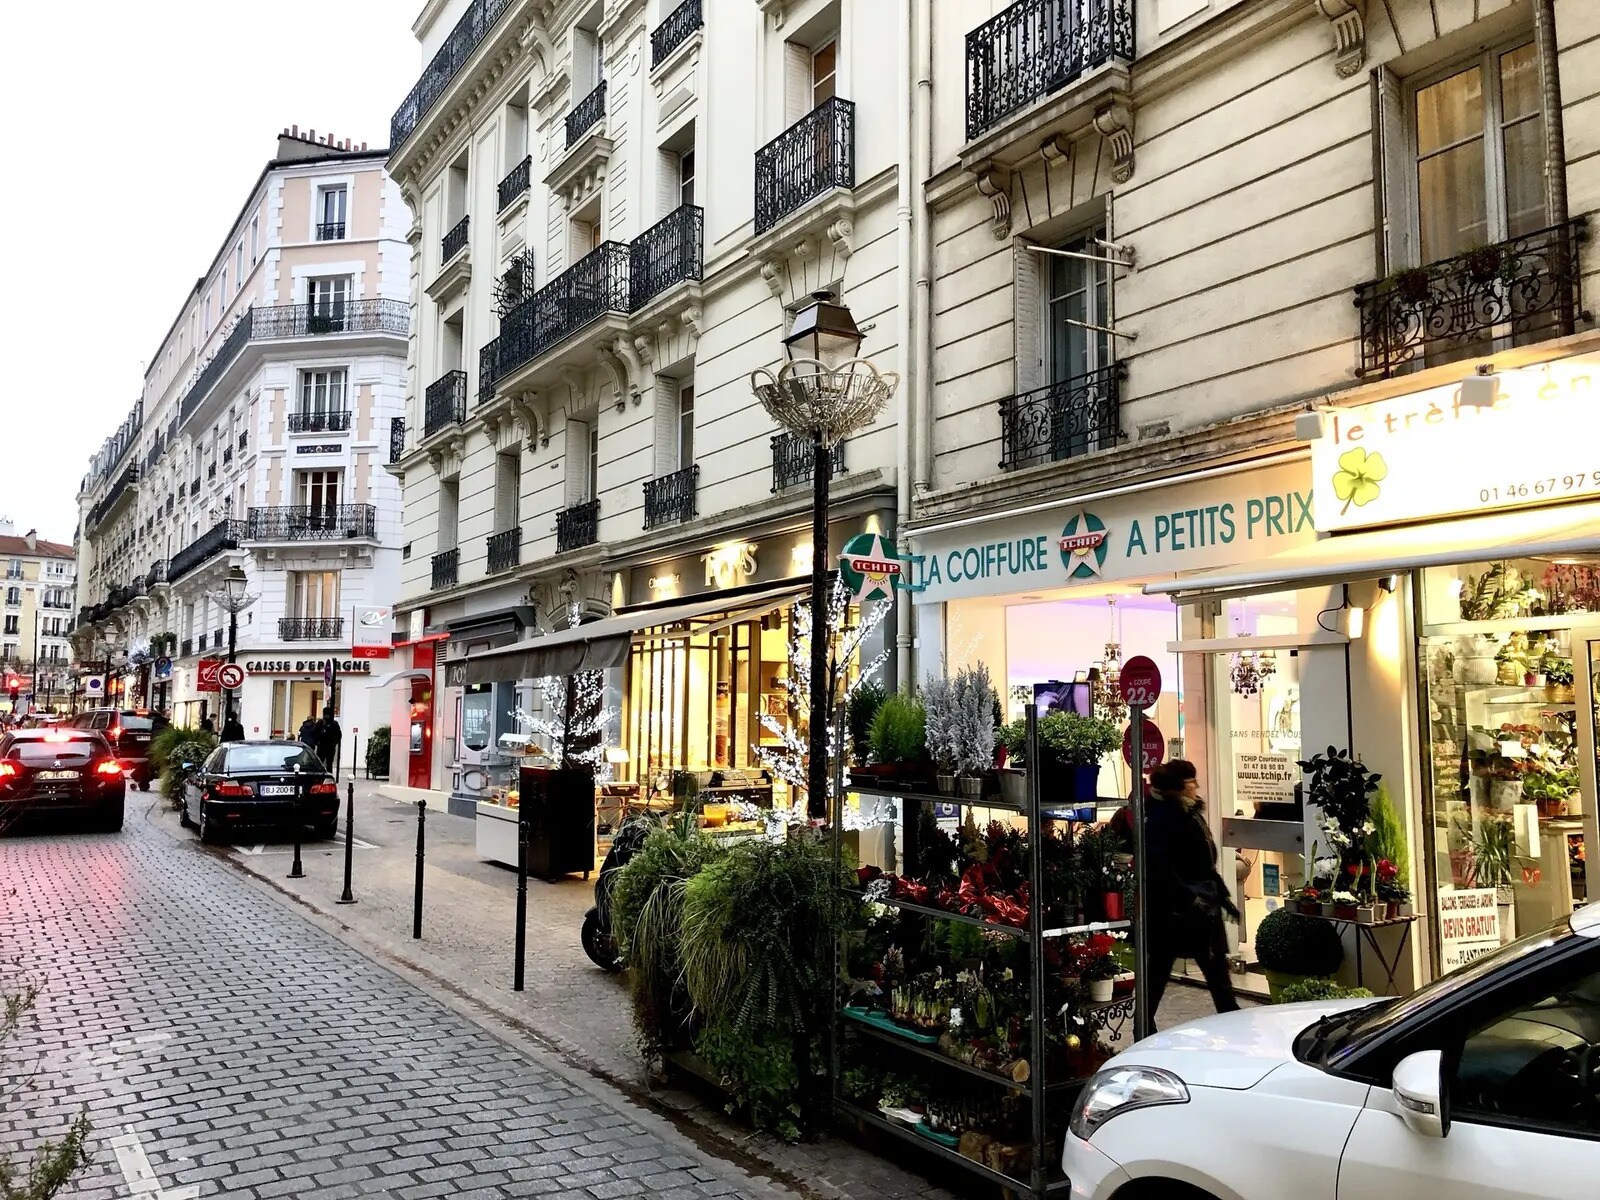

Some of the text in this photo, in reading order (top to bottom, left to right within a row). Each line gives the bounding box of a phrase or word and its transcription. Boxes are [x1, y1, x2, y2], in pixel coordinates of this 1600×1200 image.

[1332, 415, 1365, 445] le
[1480, 488, 1499, 503] 01
[1507, 484, 1529, 498] 46
[1535, 479, 1557, 495] 67
[1563, 473, 1586, 491] 97
[1126, 489, 1315, 558] A PETITS PRIX
[1061, 535, 1100, 549] TCHIP
[946, 535, 1048, 583] COIFFURE
[854, 561, 899, 573] TCHIP
[245, 660, 370, 672] CAISSE D'EPRGNE
[1229, 730, 1248, 738] SANS
[1251, 730, 1280, 738] RENDEZ
[1237, 771, 1292, 782] www.tchip.fr
[275, 786, 289, 794] 200
[1443, 915, 1496, 939] DEVIS GRATUIT
